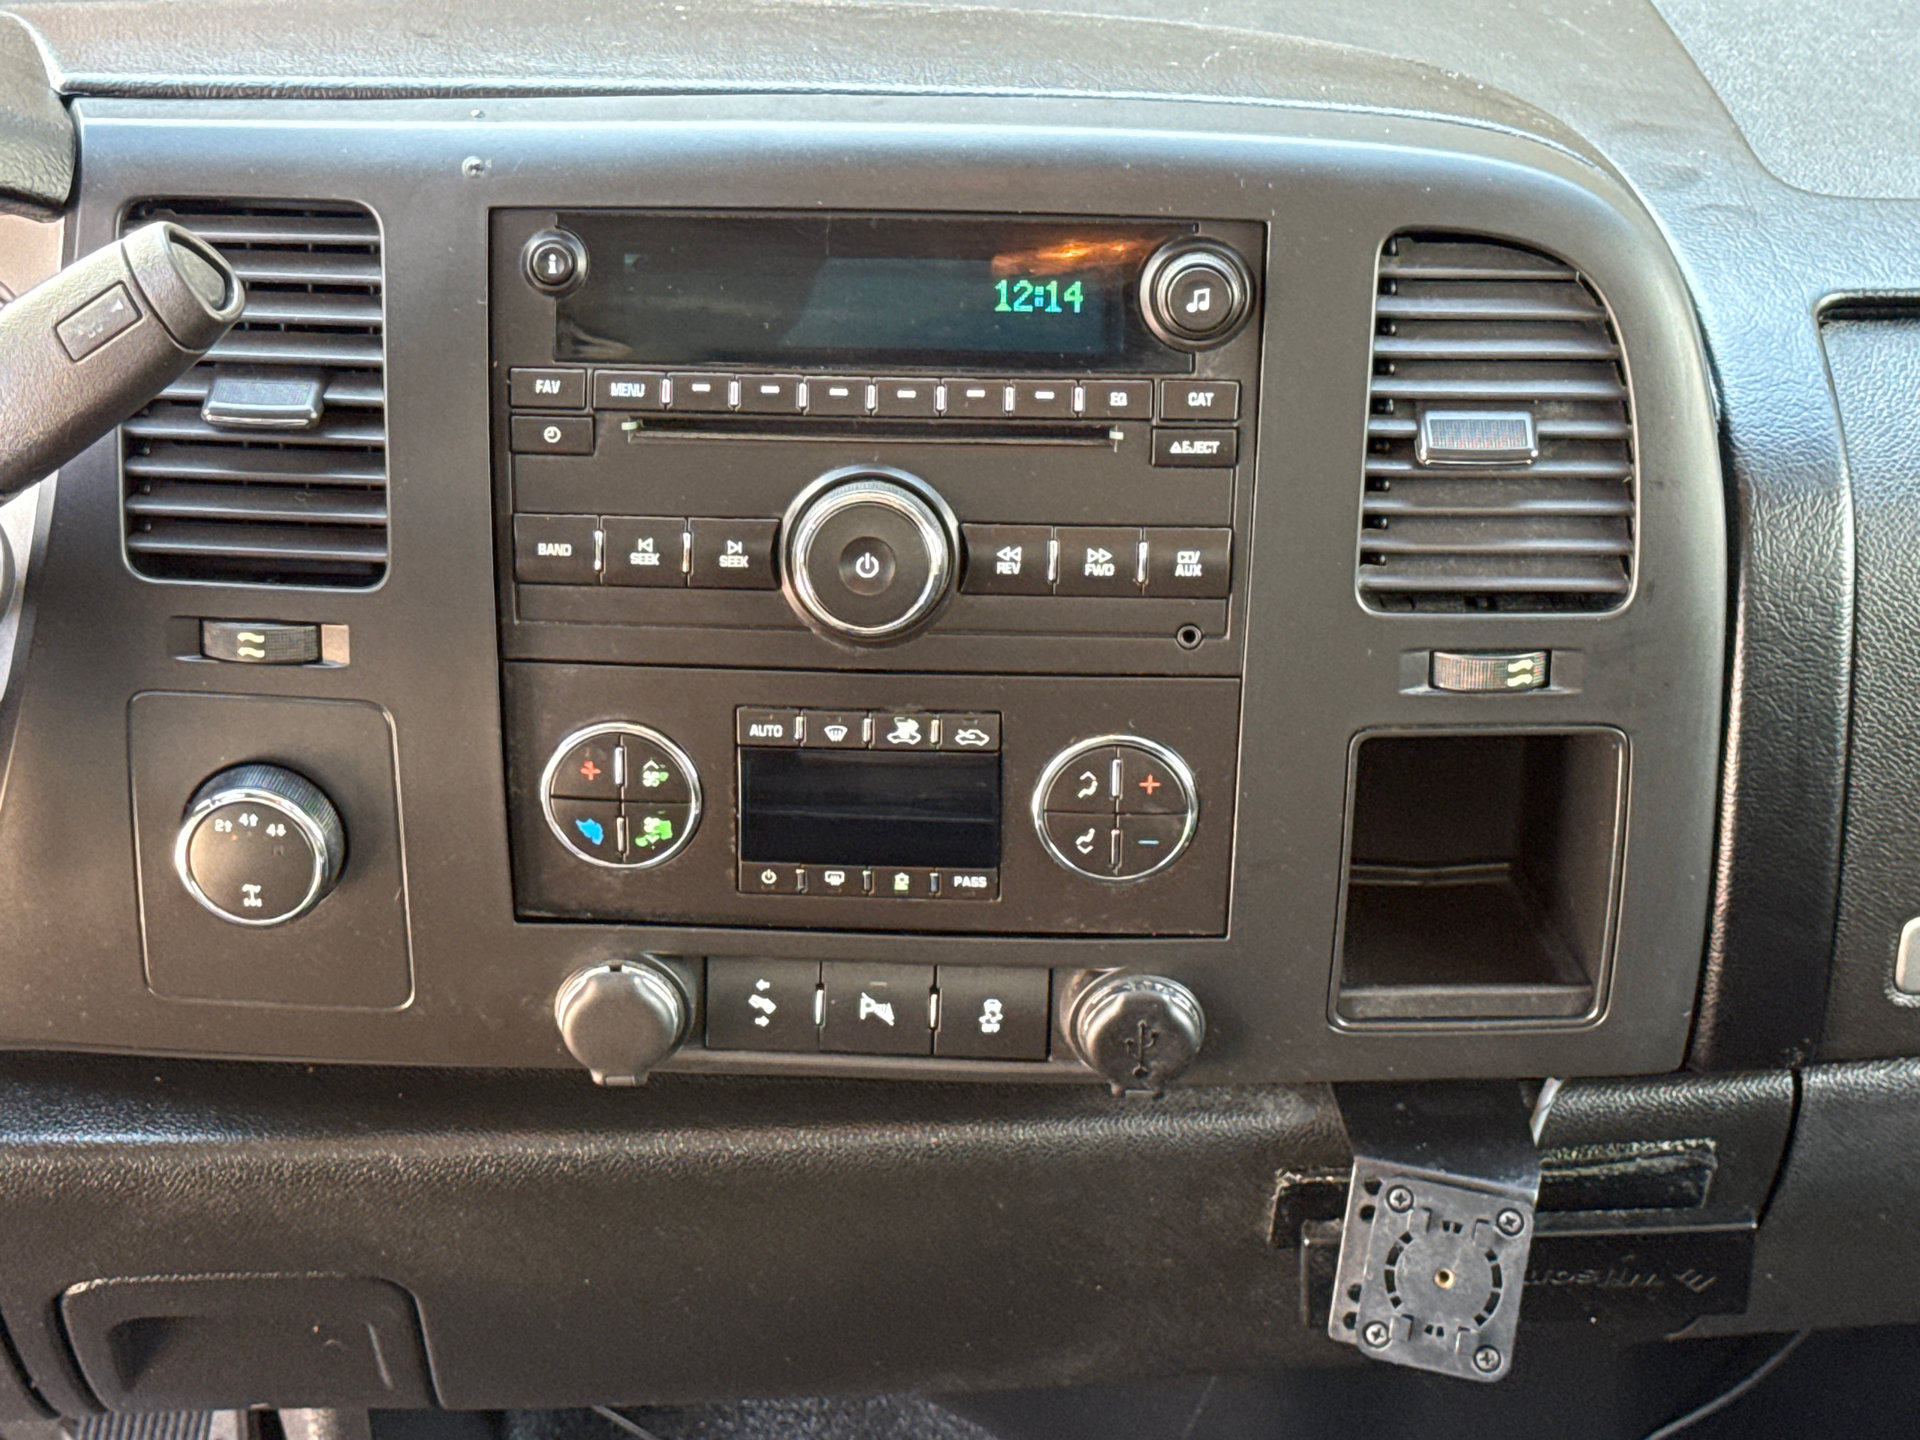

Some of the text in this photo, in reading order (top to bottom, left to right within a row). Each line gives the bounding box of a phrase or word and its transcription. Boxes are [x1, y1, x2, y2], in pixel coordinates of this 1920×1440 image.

[995, 280, 1083, 312] 12:14
[536, 380, 560, 394] FAV
[610, 382, 645, 397] MENU
[1188, 392, 1214, 406] CAT
[1182, 441, 1220, 454] EJECT
[538, 543, 572, 557] BAND
[629, 551, 660, 566] SEEK
[719, 554, 749, 568] SEEK
[997, 561, 1021, 575] REV
[1085, 563, 1115, 576] FWD
[1175, 564, 1202, 576] AUX
[750, 724, 783, 737] AUTO
[954, 876, 987, 888] PASS
